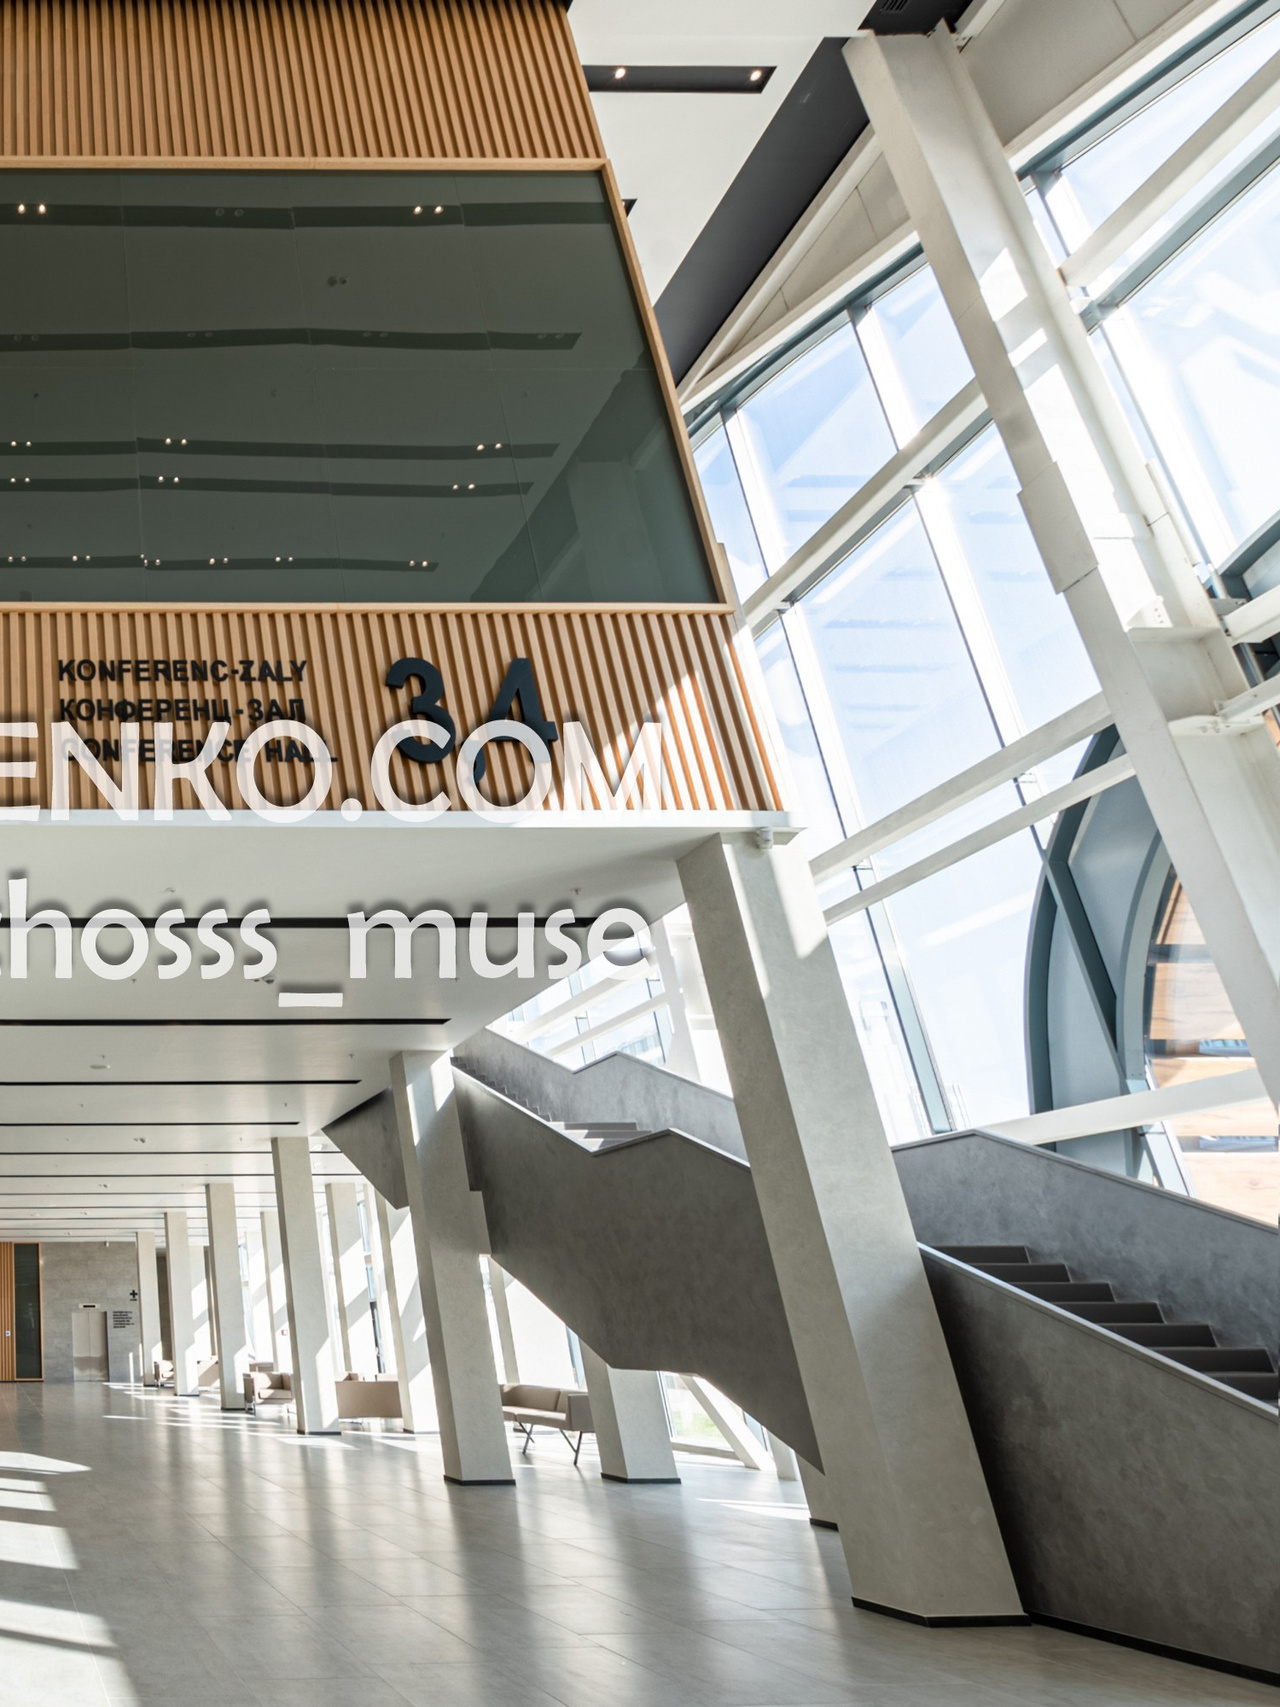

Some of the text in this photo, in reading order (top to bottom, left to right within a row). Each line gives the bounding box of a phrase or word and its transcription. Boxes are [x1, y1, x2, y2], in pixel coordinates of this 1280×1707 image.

[58, 659, 307, 682] KONFERENC-ZALY
[61, 739, 338, 762] CONFERENCE HALL
